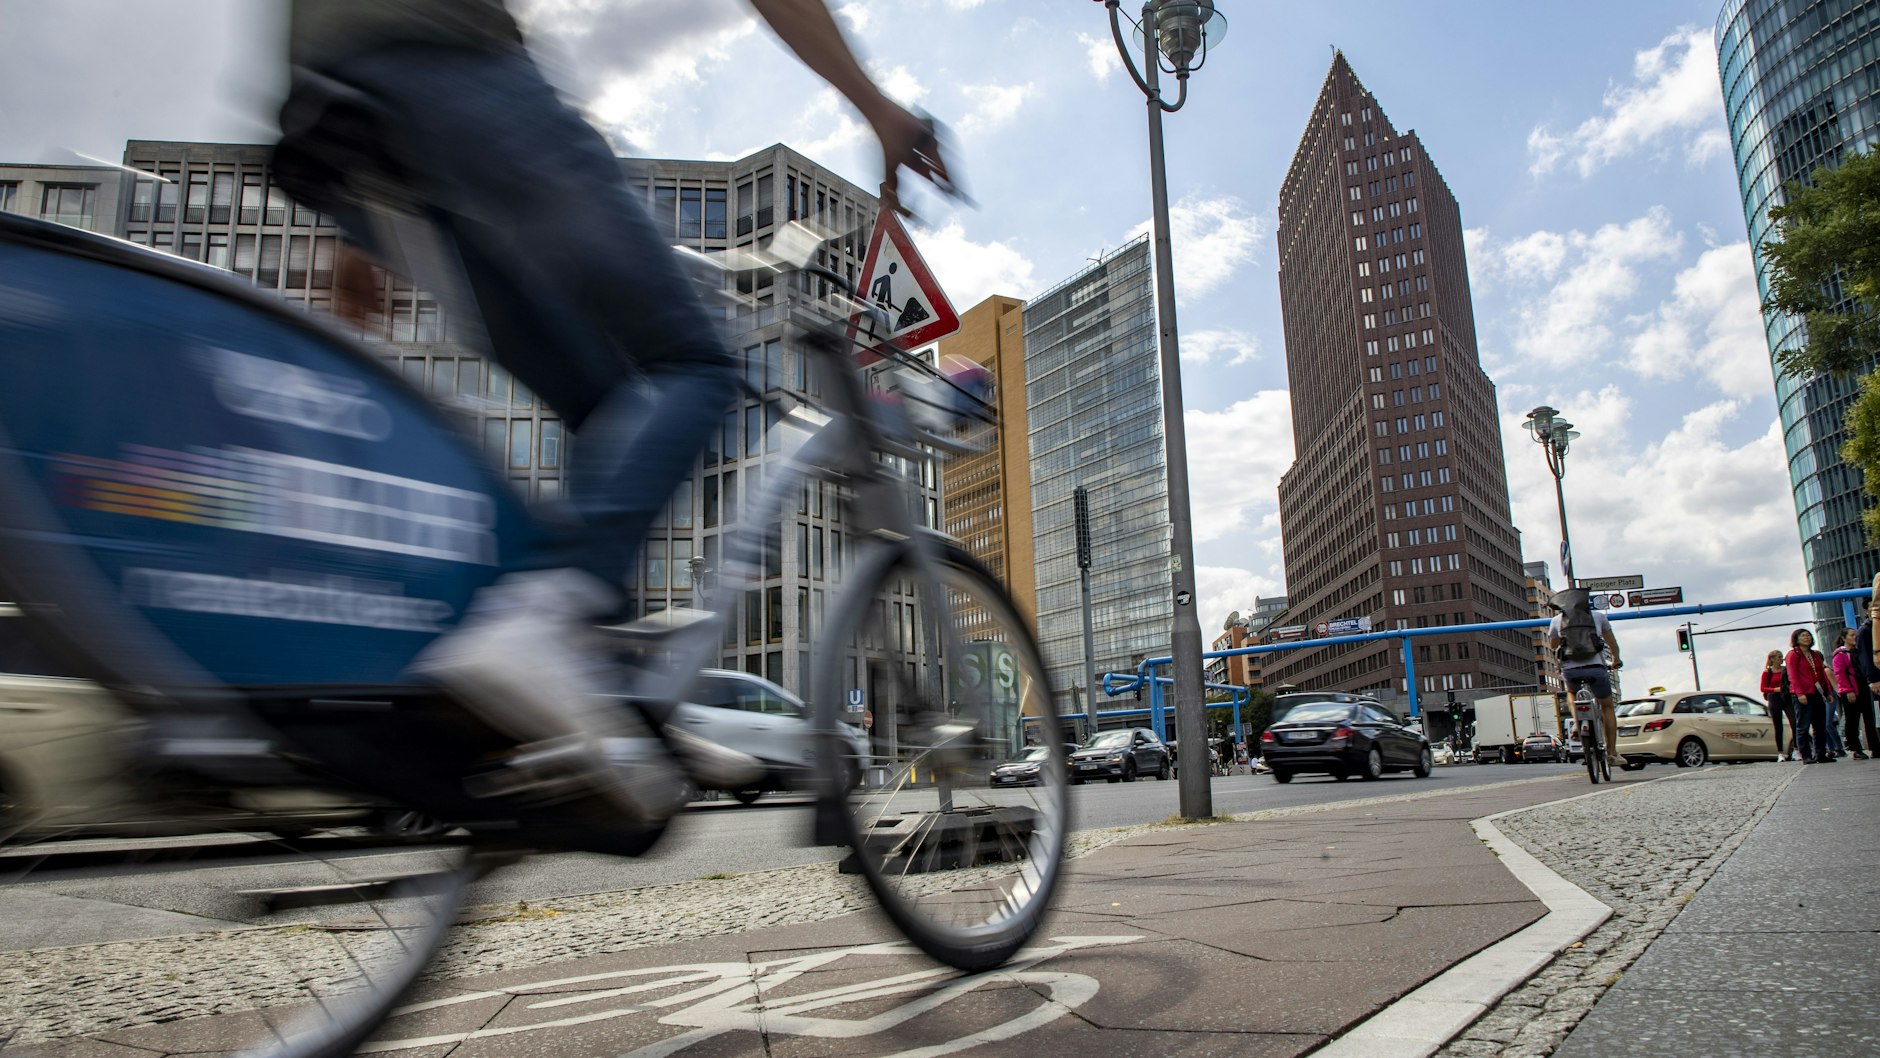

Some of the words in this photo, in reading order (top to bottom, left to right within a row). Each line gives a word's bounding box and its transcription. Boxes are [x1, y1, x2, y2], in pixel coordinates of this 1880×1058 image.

[1586, 580, 1617, 589] Leipziger
[1329, 620, 1357, 628] BRECHTEL
[998, 652, 1014, 688] S
[849, 689, 861, 705] U
